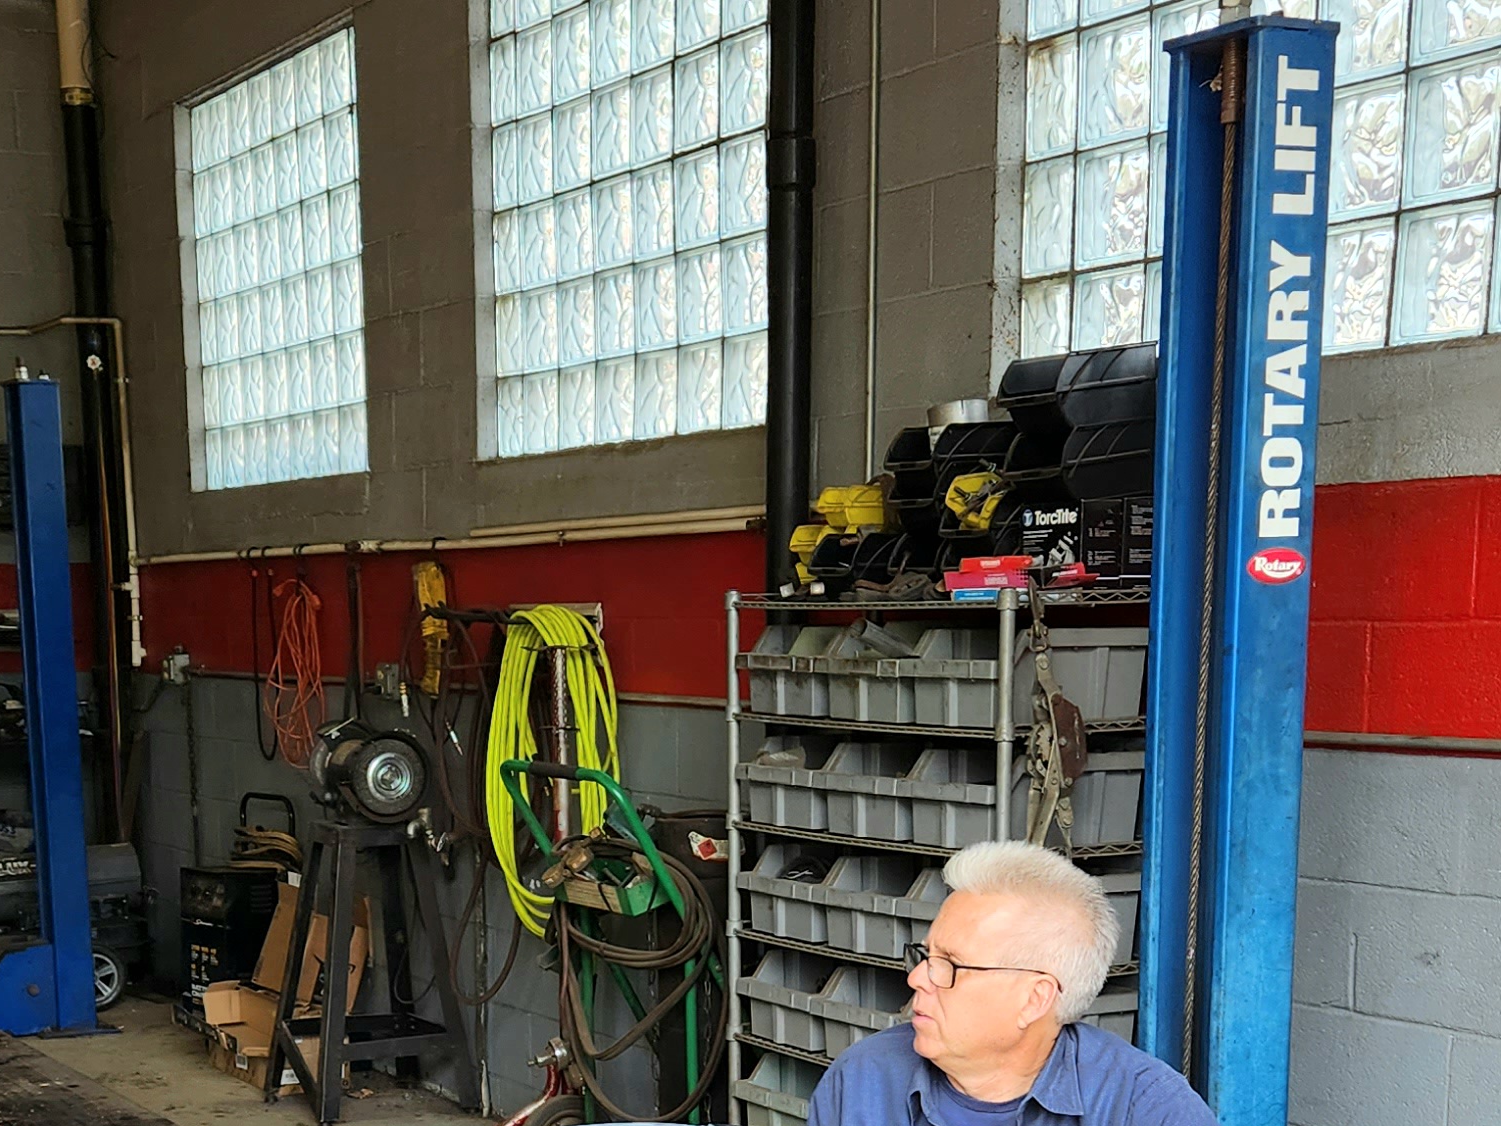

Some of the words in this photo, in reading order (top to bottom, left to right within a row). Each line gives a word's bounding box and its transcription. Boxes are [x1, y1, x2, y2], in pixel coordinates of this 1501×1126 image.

[1272, 54, 1320, 216] LIFT
[1258, 240, 1312, 538] ROTARY
[1034, 508, 1078, 526] TorcTite
[1254, 556, 1302, 578] Rotary
